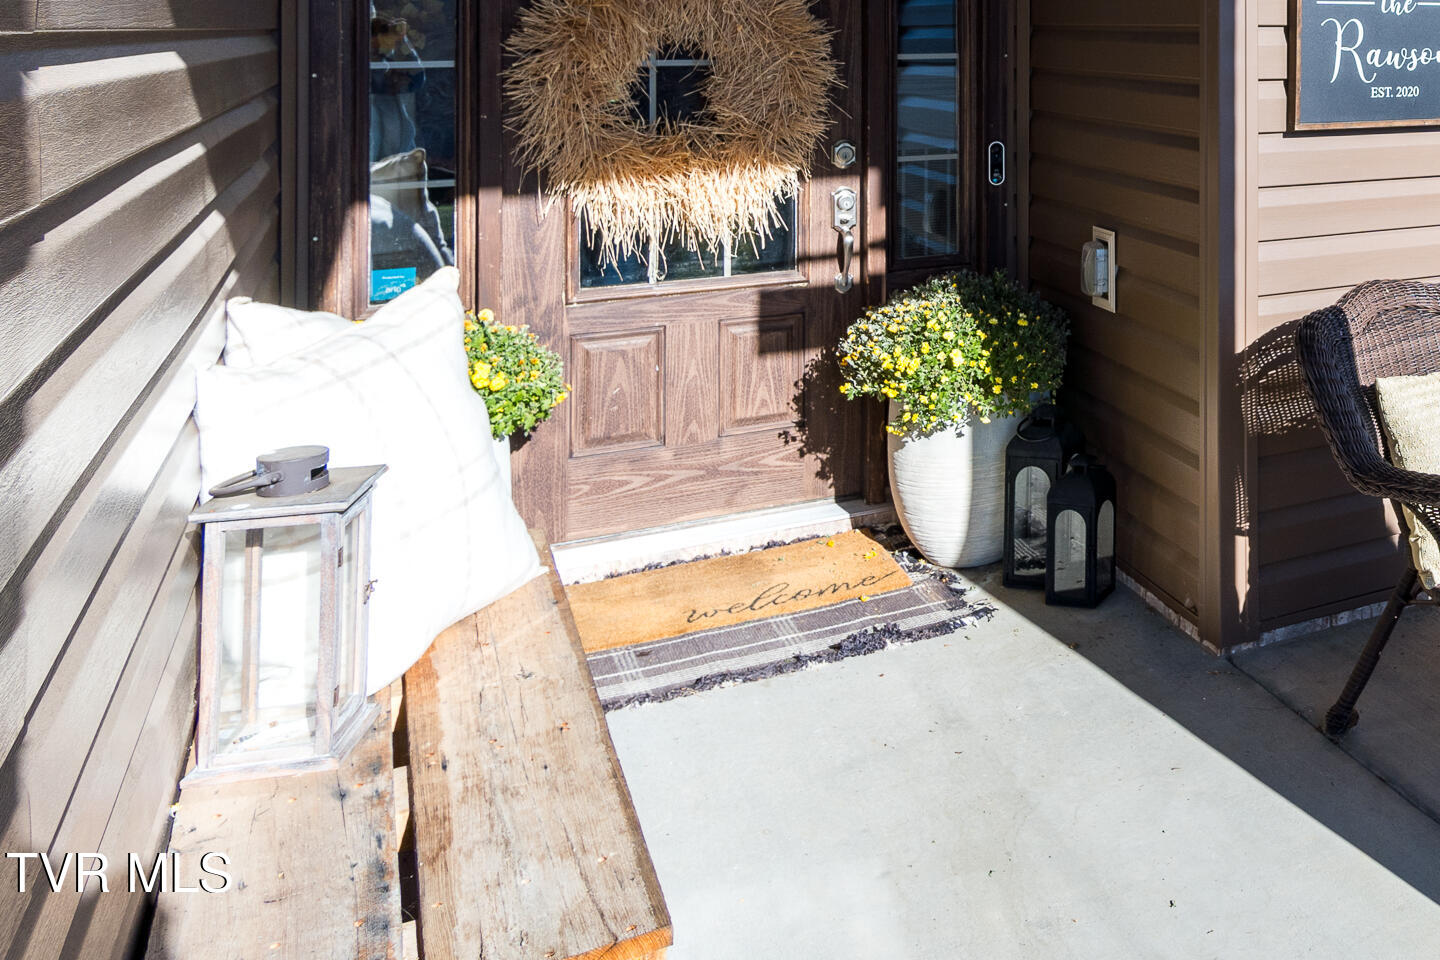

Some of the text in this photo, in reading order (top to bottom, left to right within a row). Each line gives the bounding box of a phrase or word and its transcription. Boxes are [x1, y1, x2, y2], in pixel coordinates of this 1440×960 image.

[1370, 85, 1420, 98] EST. 2020
[686, 570, 899, 624] welcome
